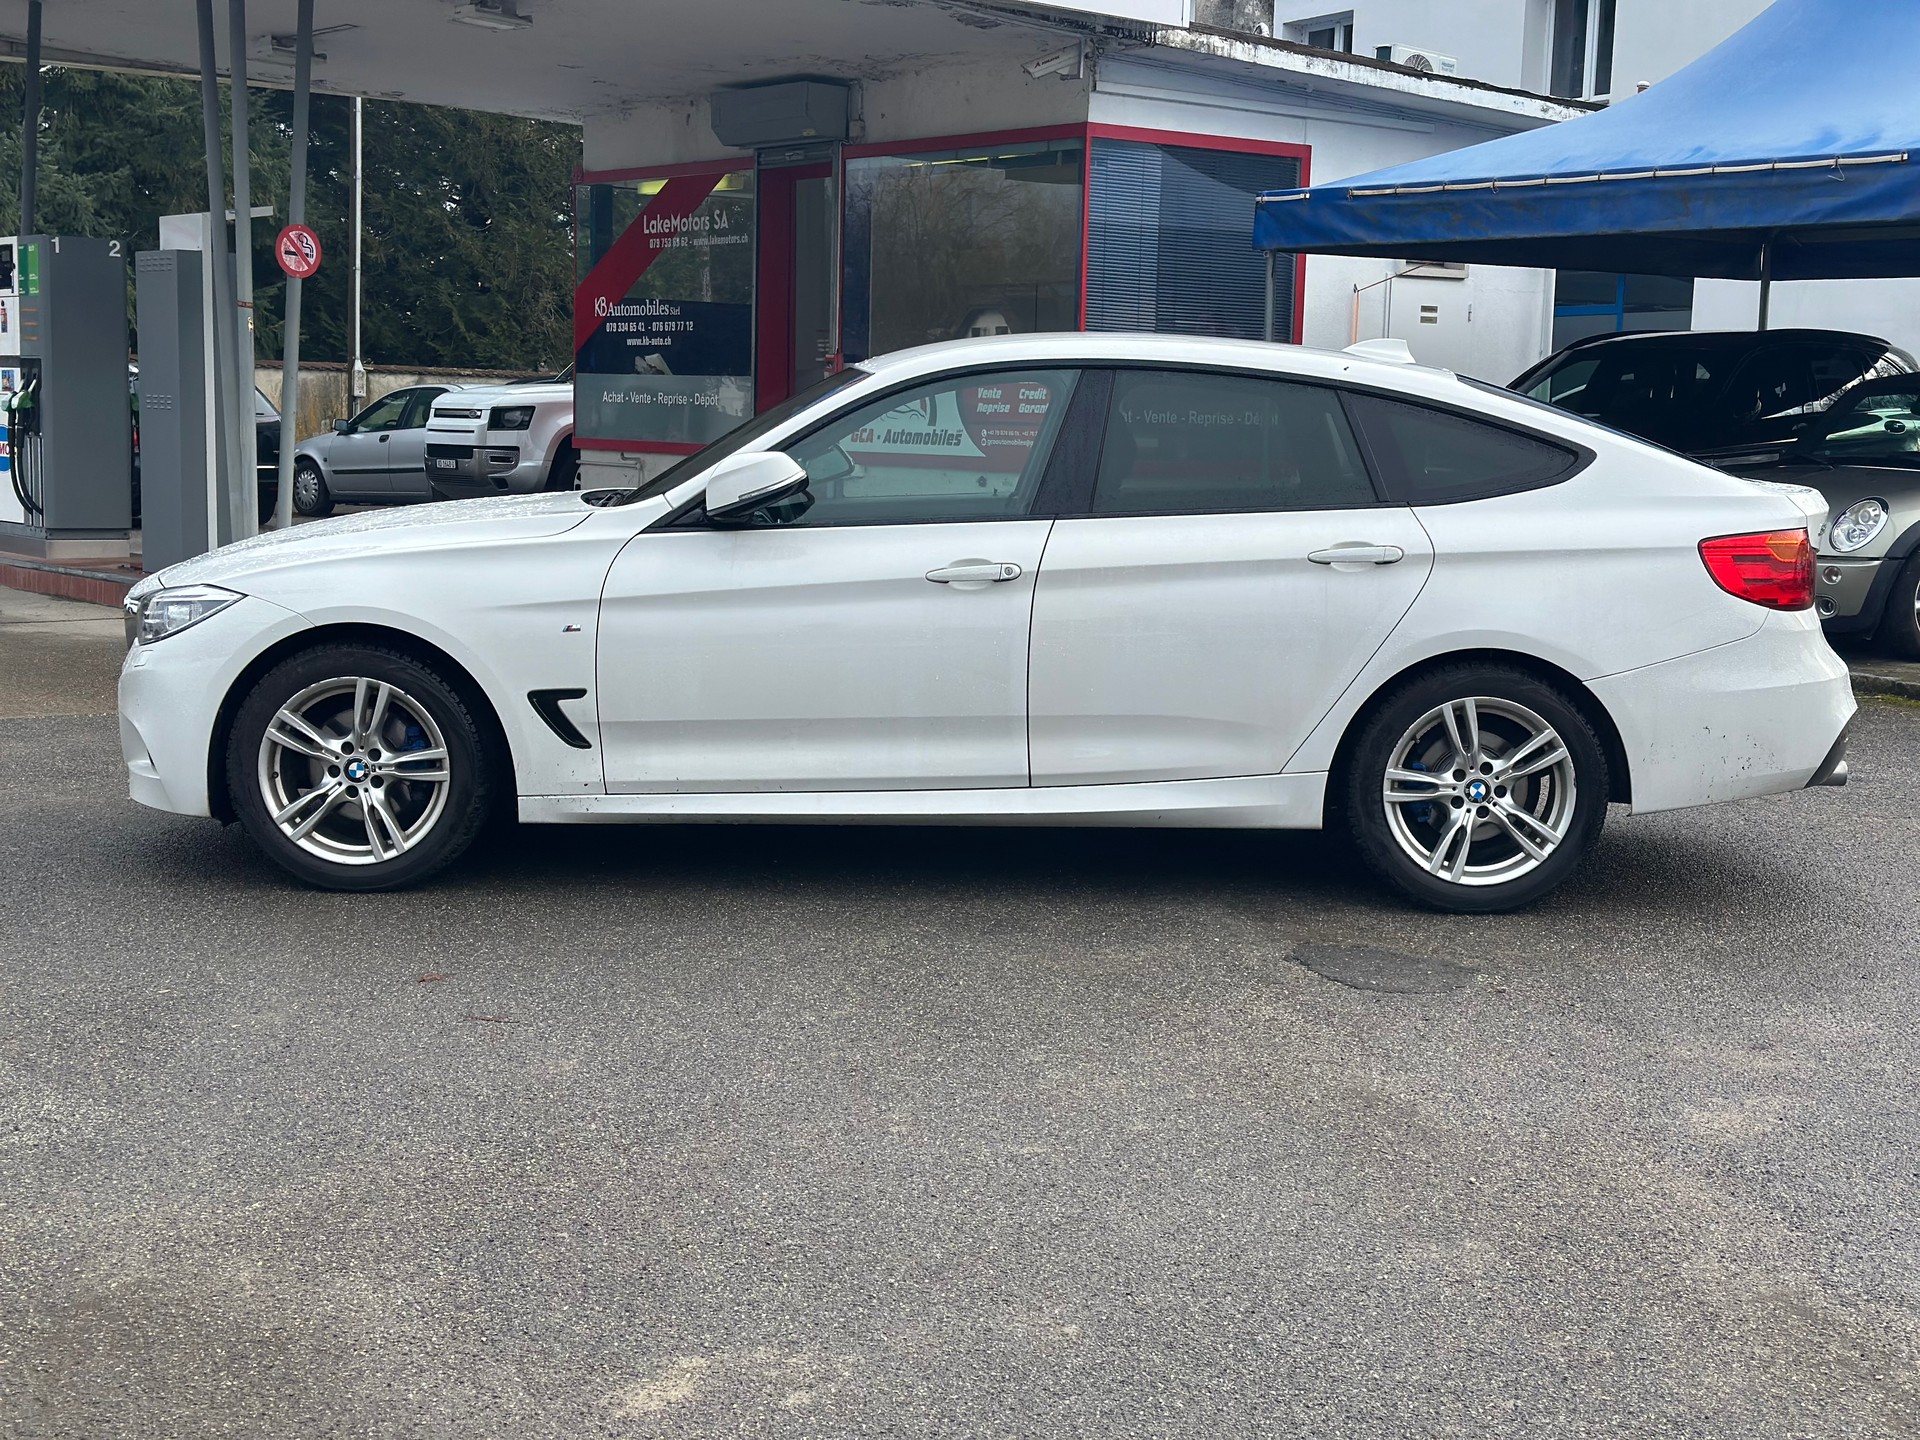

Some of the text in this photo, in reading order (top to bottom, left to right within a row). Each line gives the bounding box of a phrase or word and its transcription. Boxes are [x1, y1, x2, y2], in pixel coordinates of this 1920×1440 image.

[643, 209, 729, 234] LakeMotors SA
[50, 236, 60, 254] 1
[108, 239, 121, 258] 2
[649, 238, 660, 249] 079
[693, 232, 749, 247] www.lakemotors.ch
[605, 322, 617, 333] 079
[617, 322, 629, 332] 334
[629, 322, 637, 332] 65
[637, 322, 645, 332] 41
[652, 321, 664, 332] 076
[664, 321, 676, 332] 679
[676, 321, 685, 332] 77
[685, 321, 694, 331] 12
[626, 335, 672, 346] www.kb-auto.ch
[602, 390, 624, 403] Achat
[629, 391, 651, 404] Vente
[657, 392, 688, 407] Reprise
[694, 393, 719, 408] Dépôt
[977, 387, 1002, 399] Vente
[1018, 387, 1047, 399] Credit
[976, 402, 1010, 415] Reprise
[1143, 409, 1177, 424] Vente
[1188, 410, 1234, 427] Reprise
[882, 428, 962, 447] Automobiles
